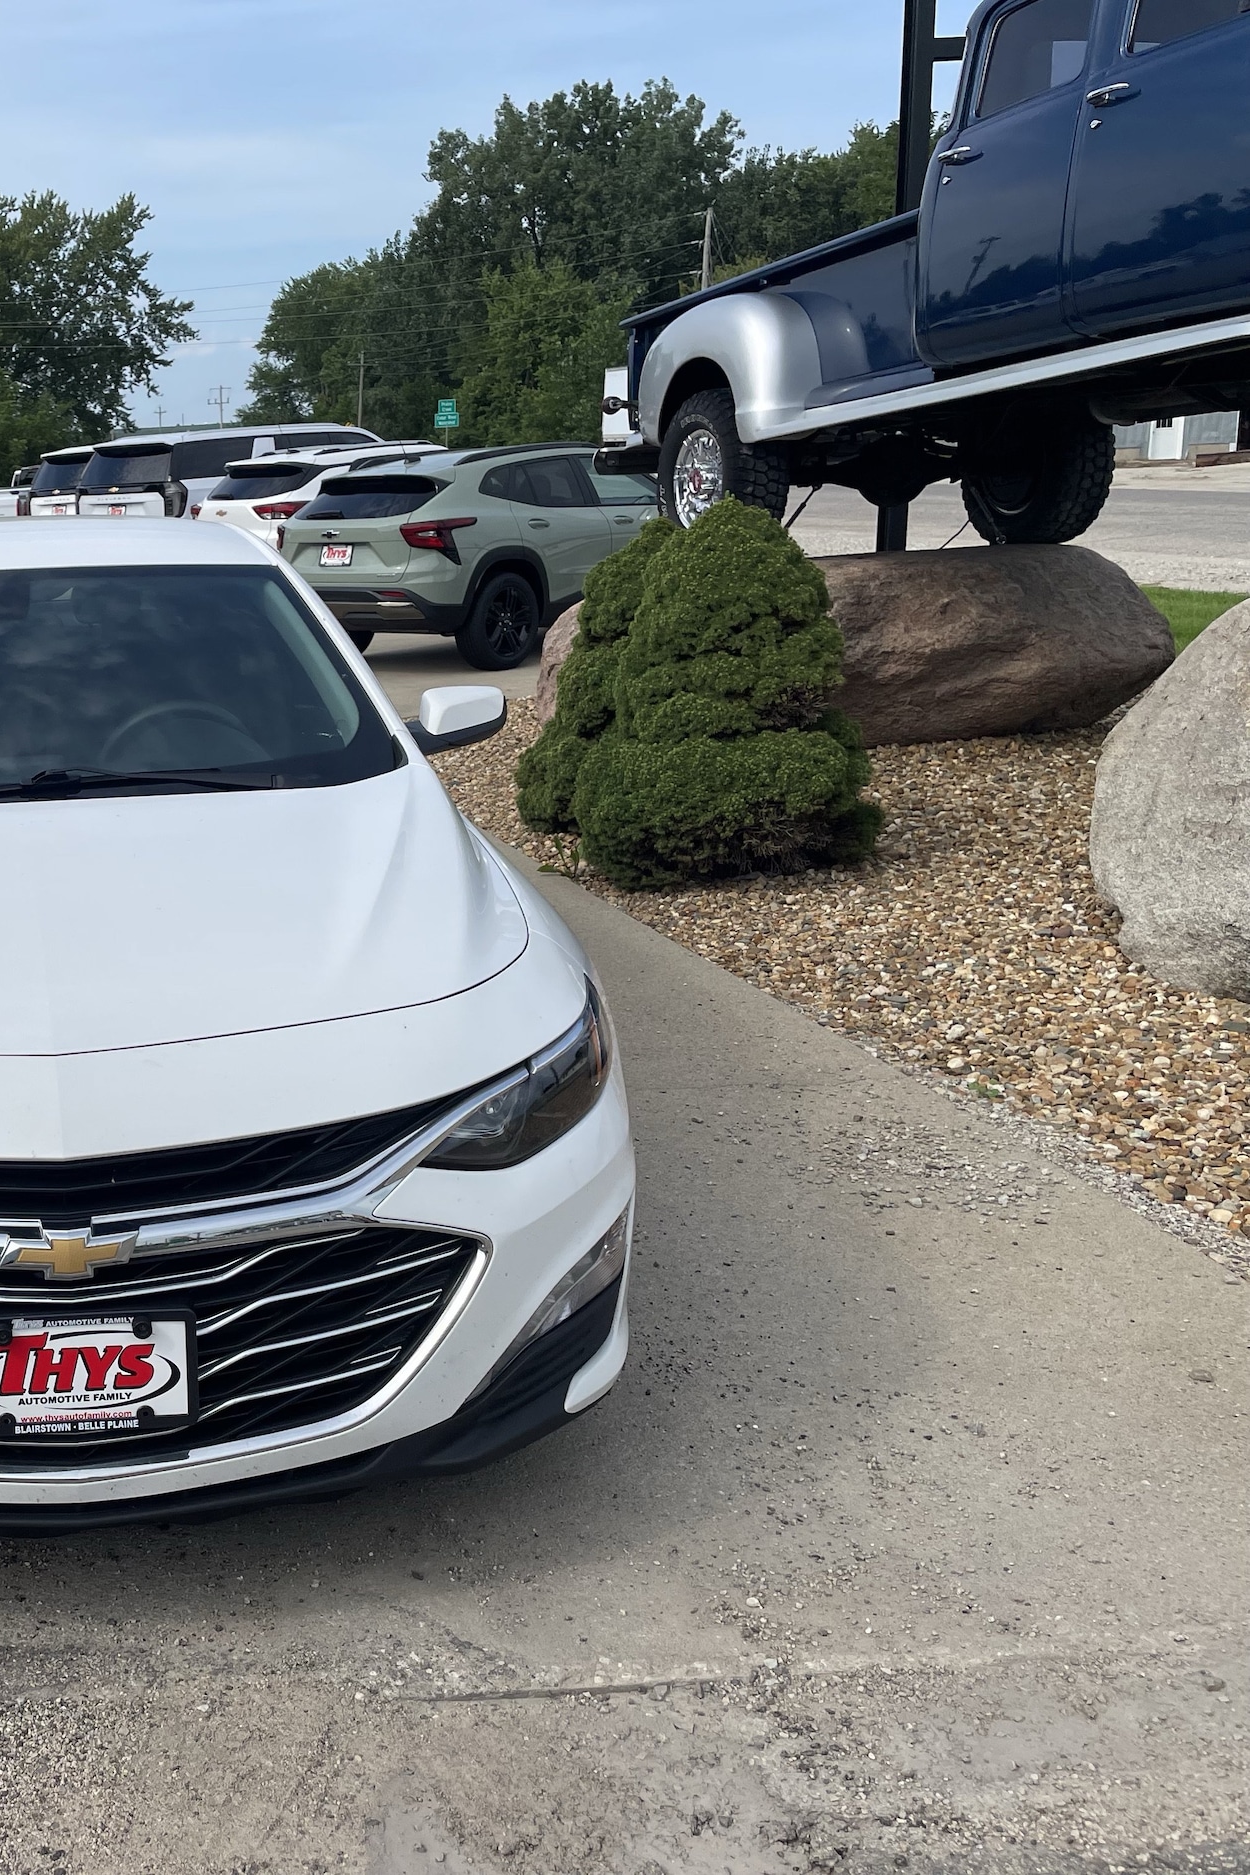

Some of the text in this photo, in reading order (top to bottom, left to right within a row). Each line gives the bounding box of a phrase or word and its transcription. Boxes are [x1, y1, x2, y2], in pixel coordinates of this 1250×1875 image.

[46, 1318, 101, 1327] AUTOMOTIVE
[104, 1317, 135, 1325] FAMILY
[18, 1392, 133, 1406] AUTOMOTIVE FAMILY
[20, 1410, 132, 1423] www.thysautofamily.com
[15, 1419, 139, 1434] BLAIRSTOWN BELLE PLAINE
